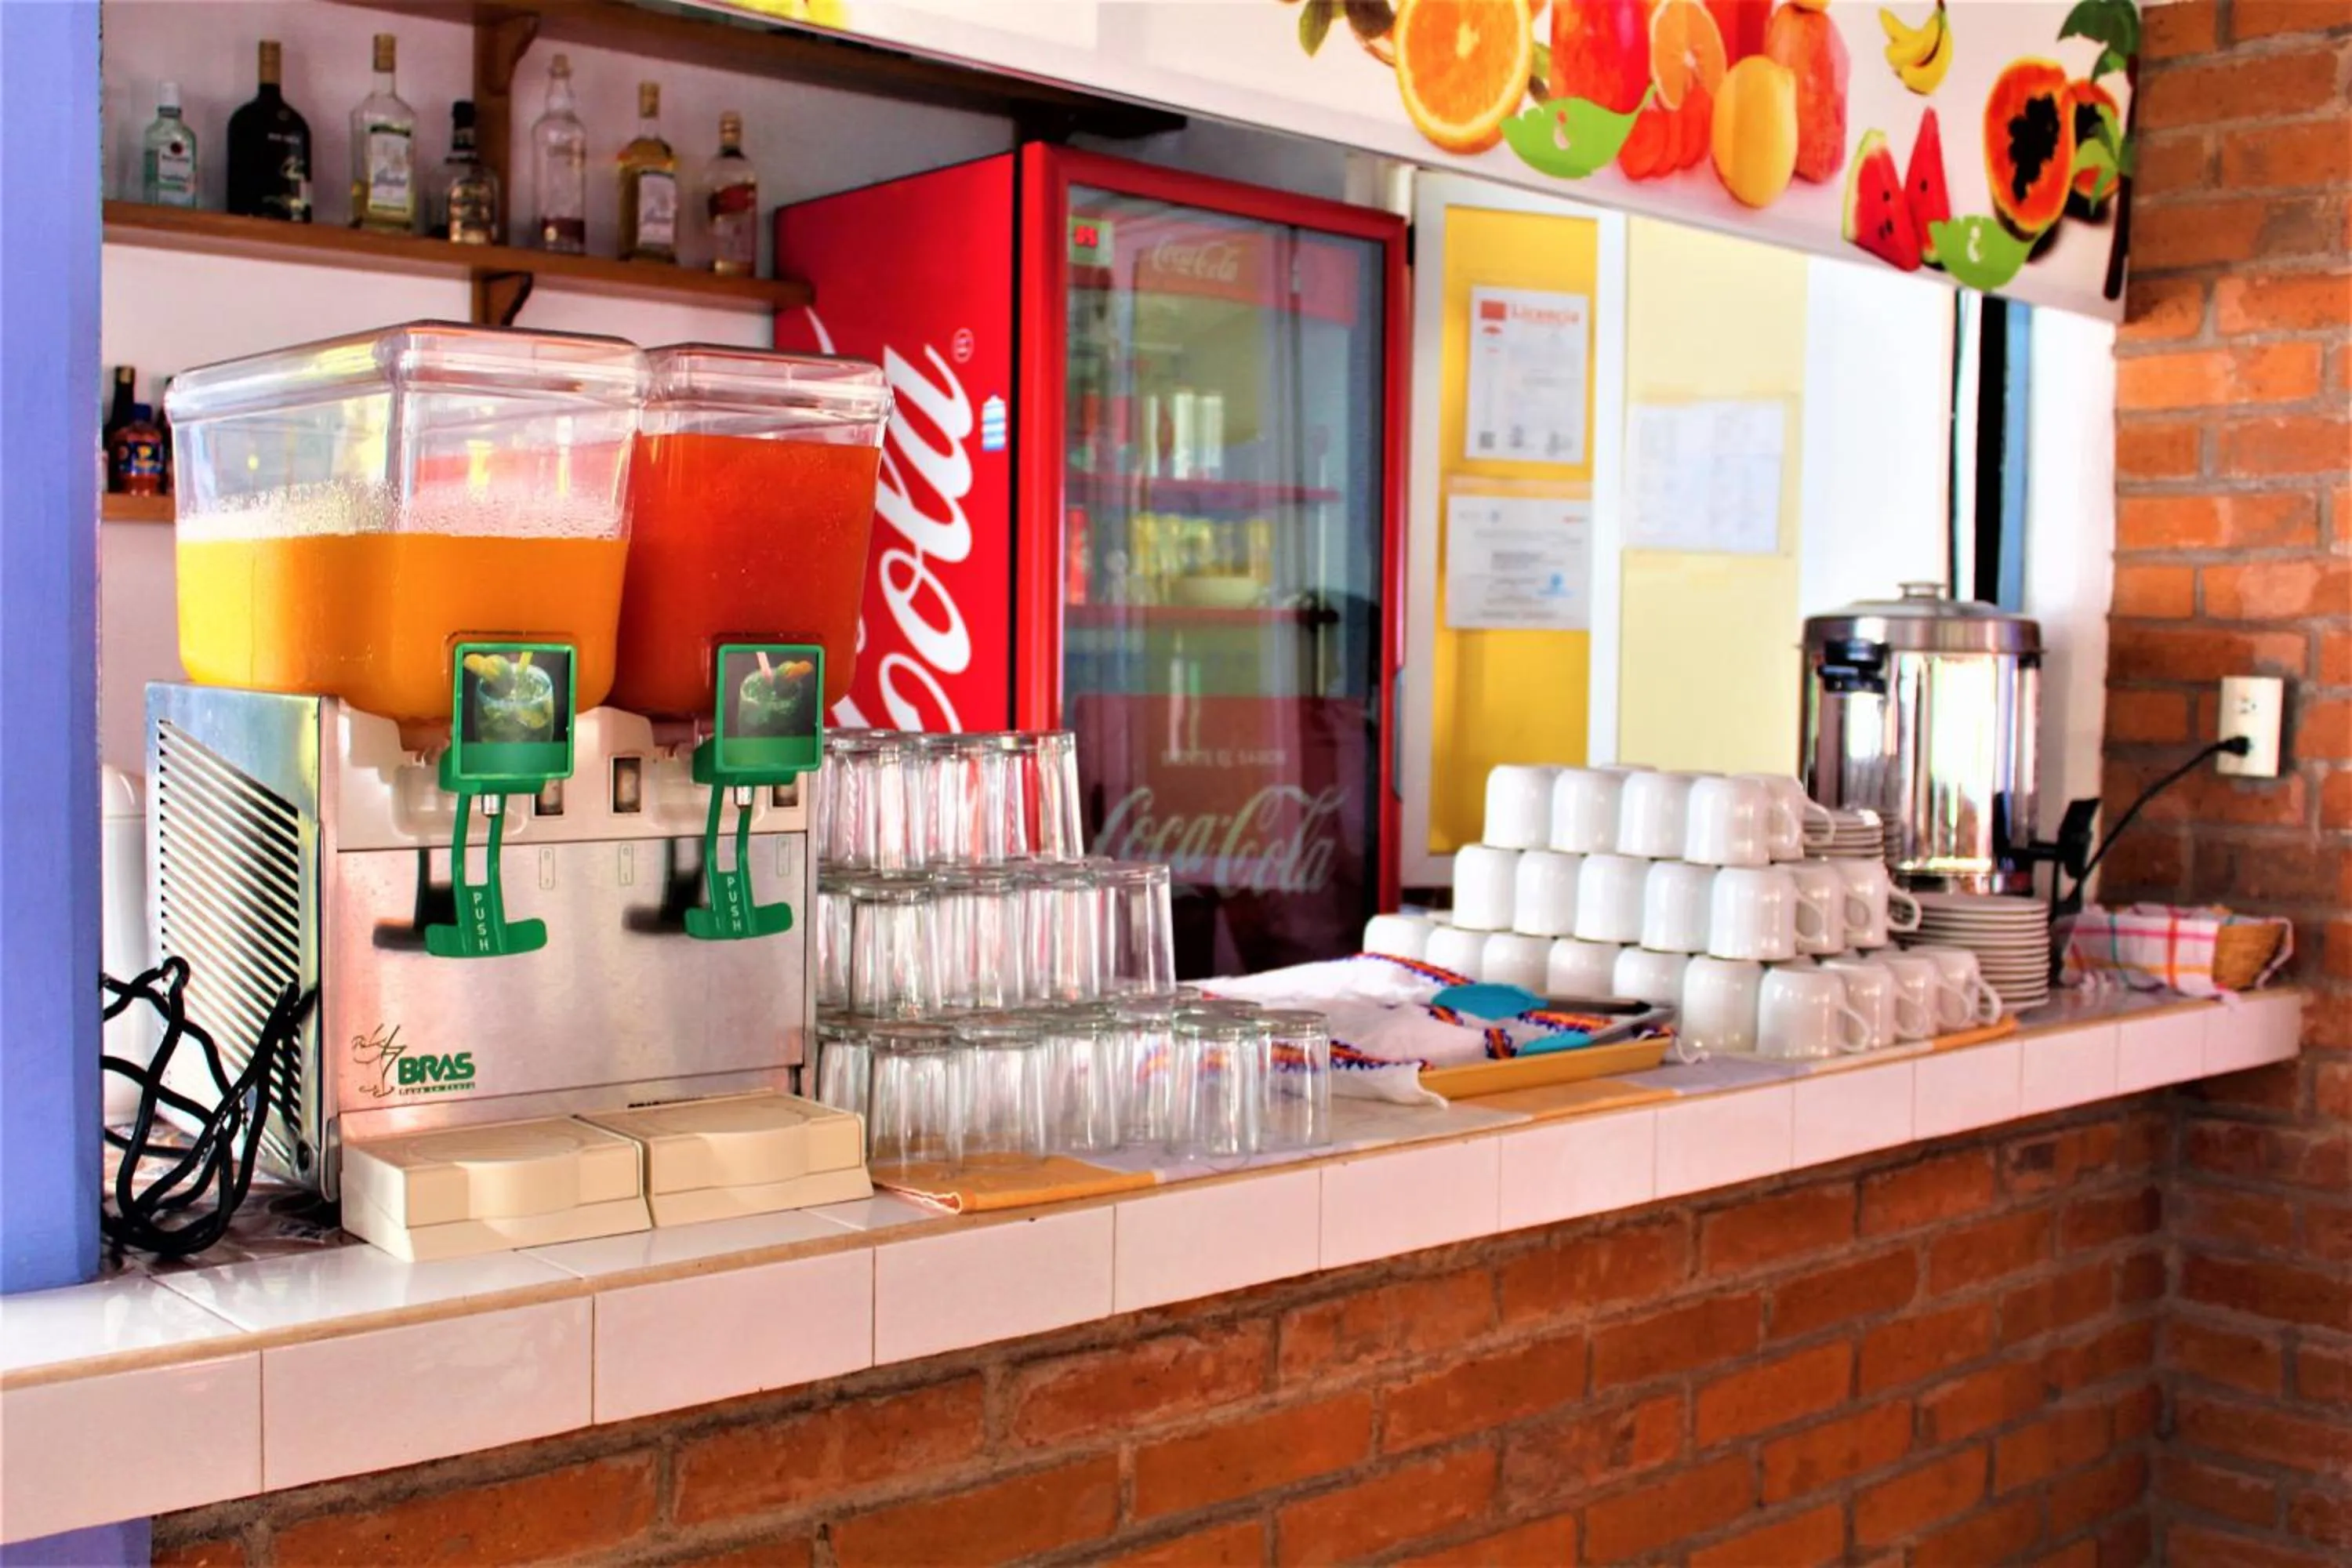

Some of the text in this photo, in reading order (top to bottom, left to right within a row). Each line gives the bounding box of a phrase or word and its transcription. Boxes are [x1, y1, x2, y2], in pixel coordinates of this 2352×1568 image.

[473, 891, 489, 951] PUSH
[727, 875, 742, 931] PUSH
[397, 1052, 475, 1085] BRAS
